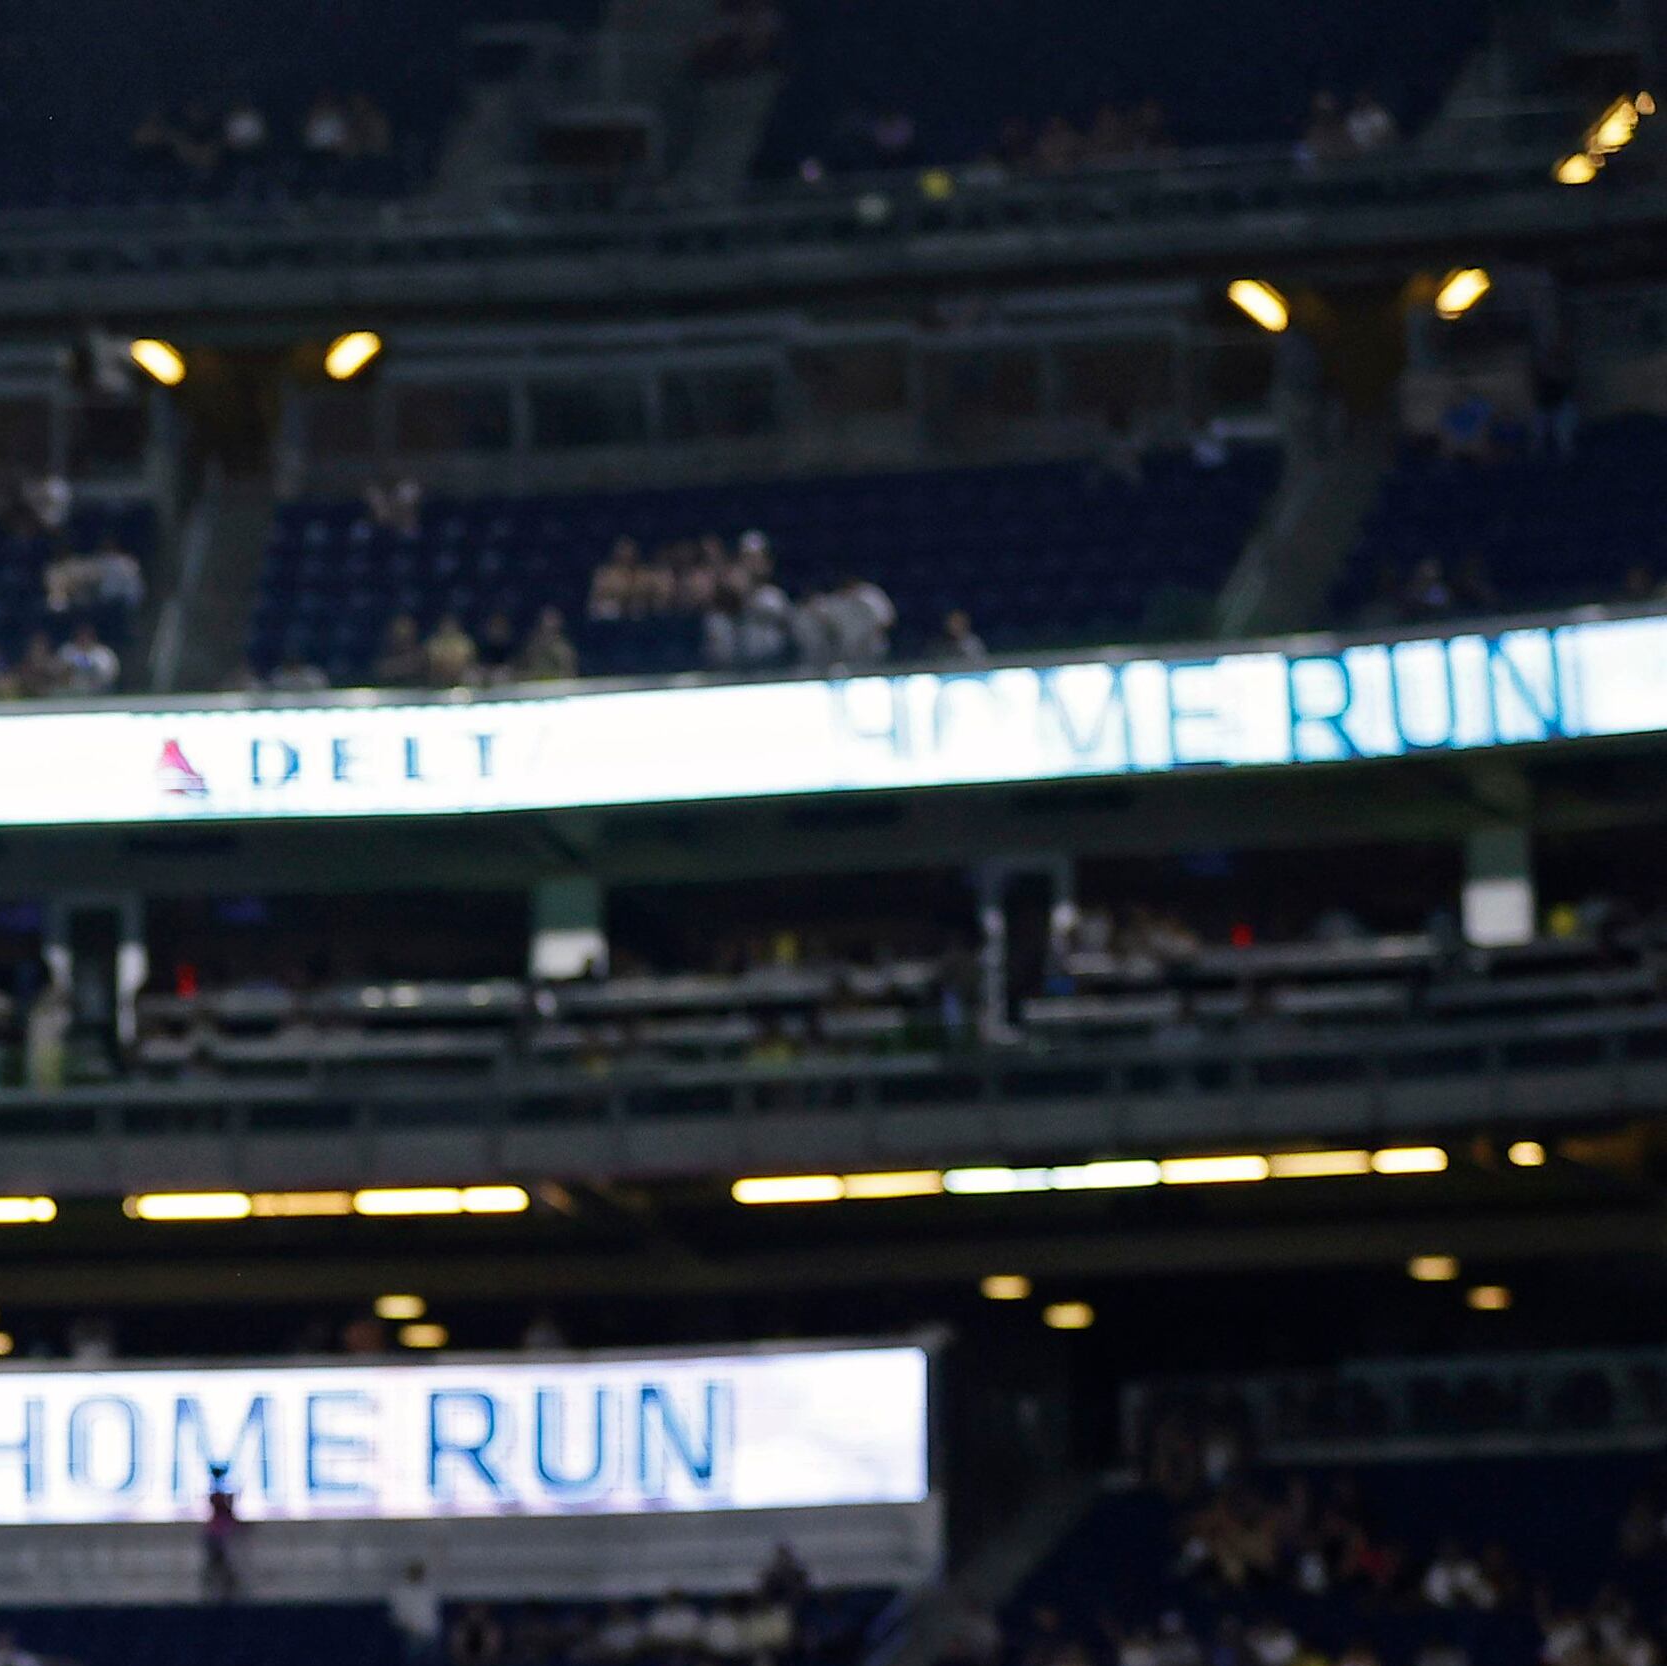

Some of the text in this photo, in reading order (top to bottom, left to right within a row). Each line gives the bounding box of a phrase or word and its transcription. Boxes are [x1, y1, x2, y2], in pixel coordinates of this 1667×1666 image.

[1287, 630, 1567, 762] RUN
[249, 731, 553, 790] DELT
[425, 1378, 733, 1502] RUN
